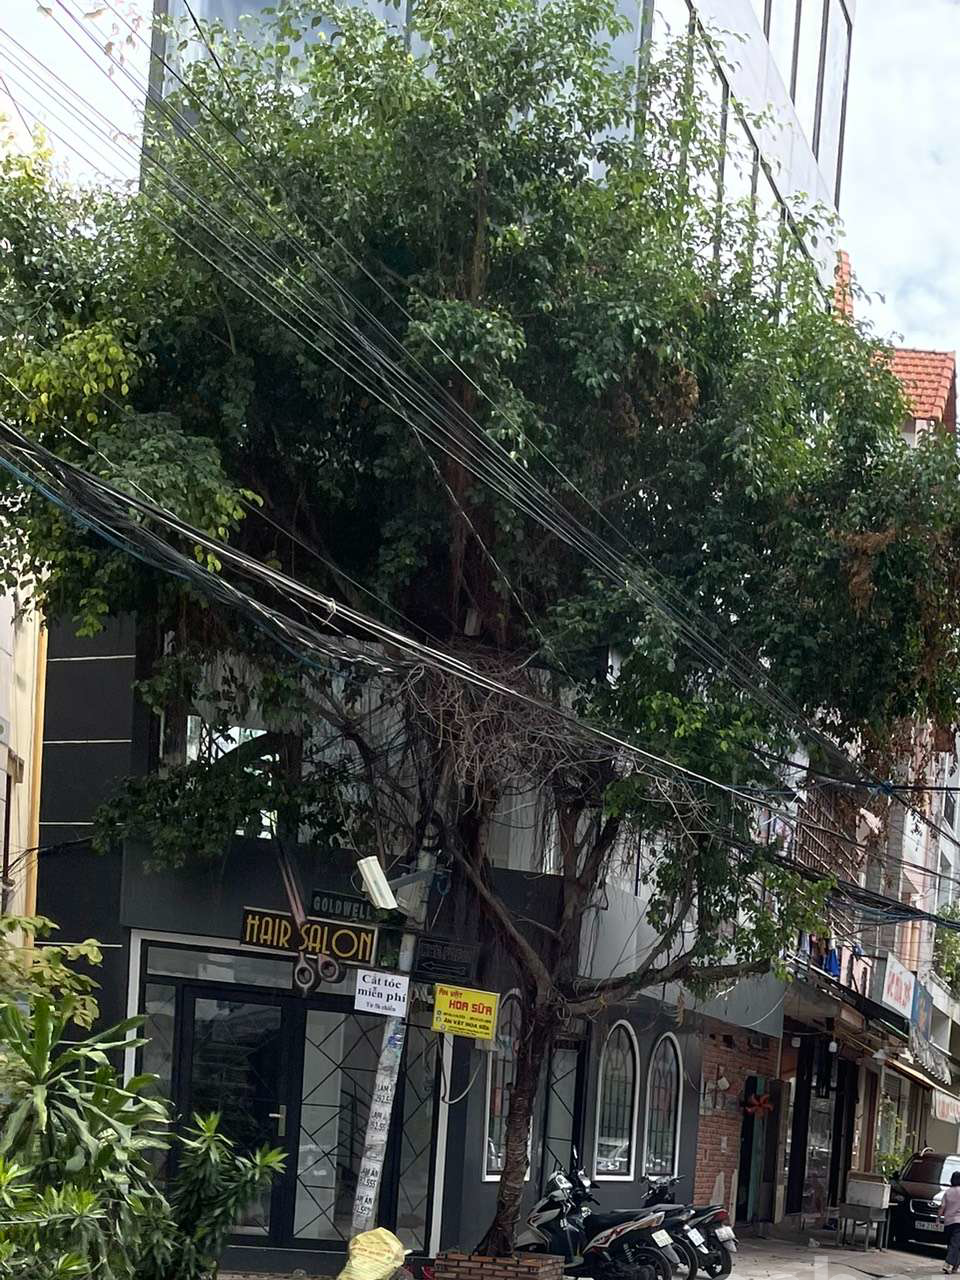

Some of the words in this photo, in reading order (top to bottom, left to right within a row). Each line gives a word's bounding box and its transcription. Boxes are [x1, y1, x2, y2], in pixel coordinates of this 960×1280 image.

[313, 896, 372, 920] GOLDWELL
[246, 914, 292, 948] HAIR
[298, 923, 373, 961] SALON
[384, 978, 402, 989] tóc
[386, 992, 406, 1003] phí
[449, 1000, 469, 1011] HOA
